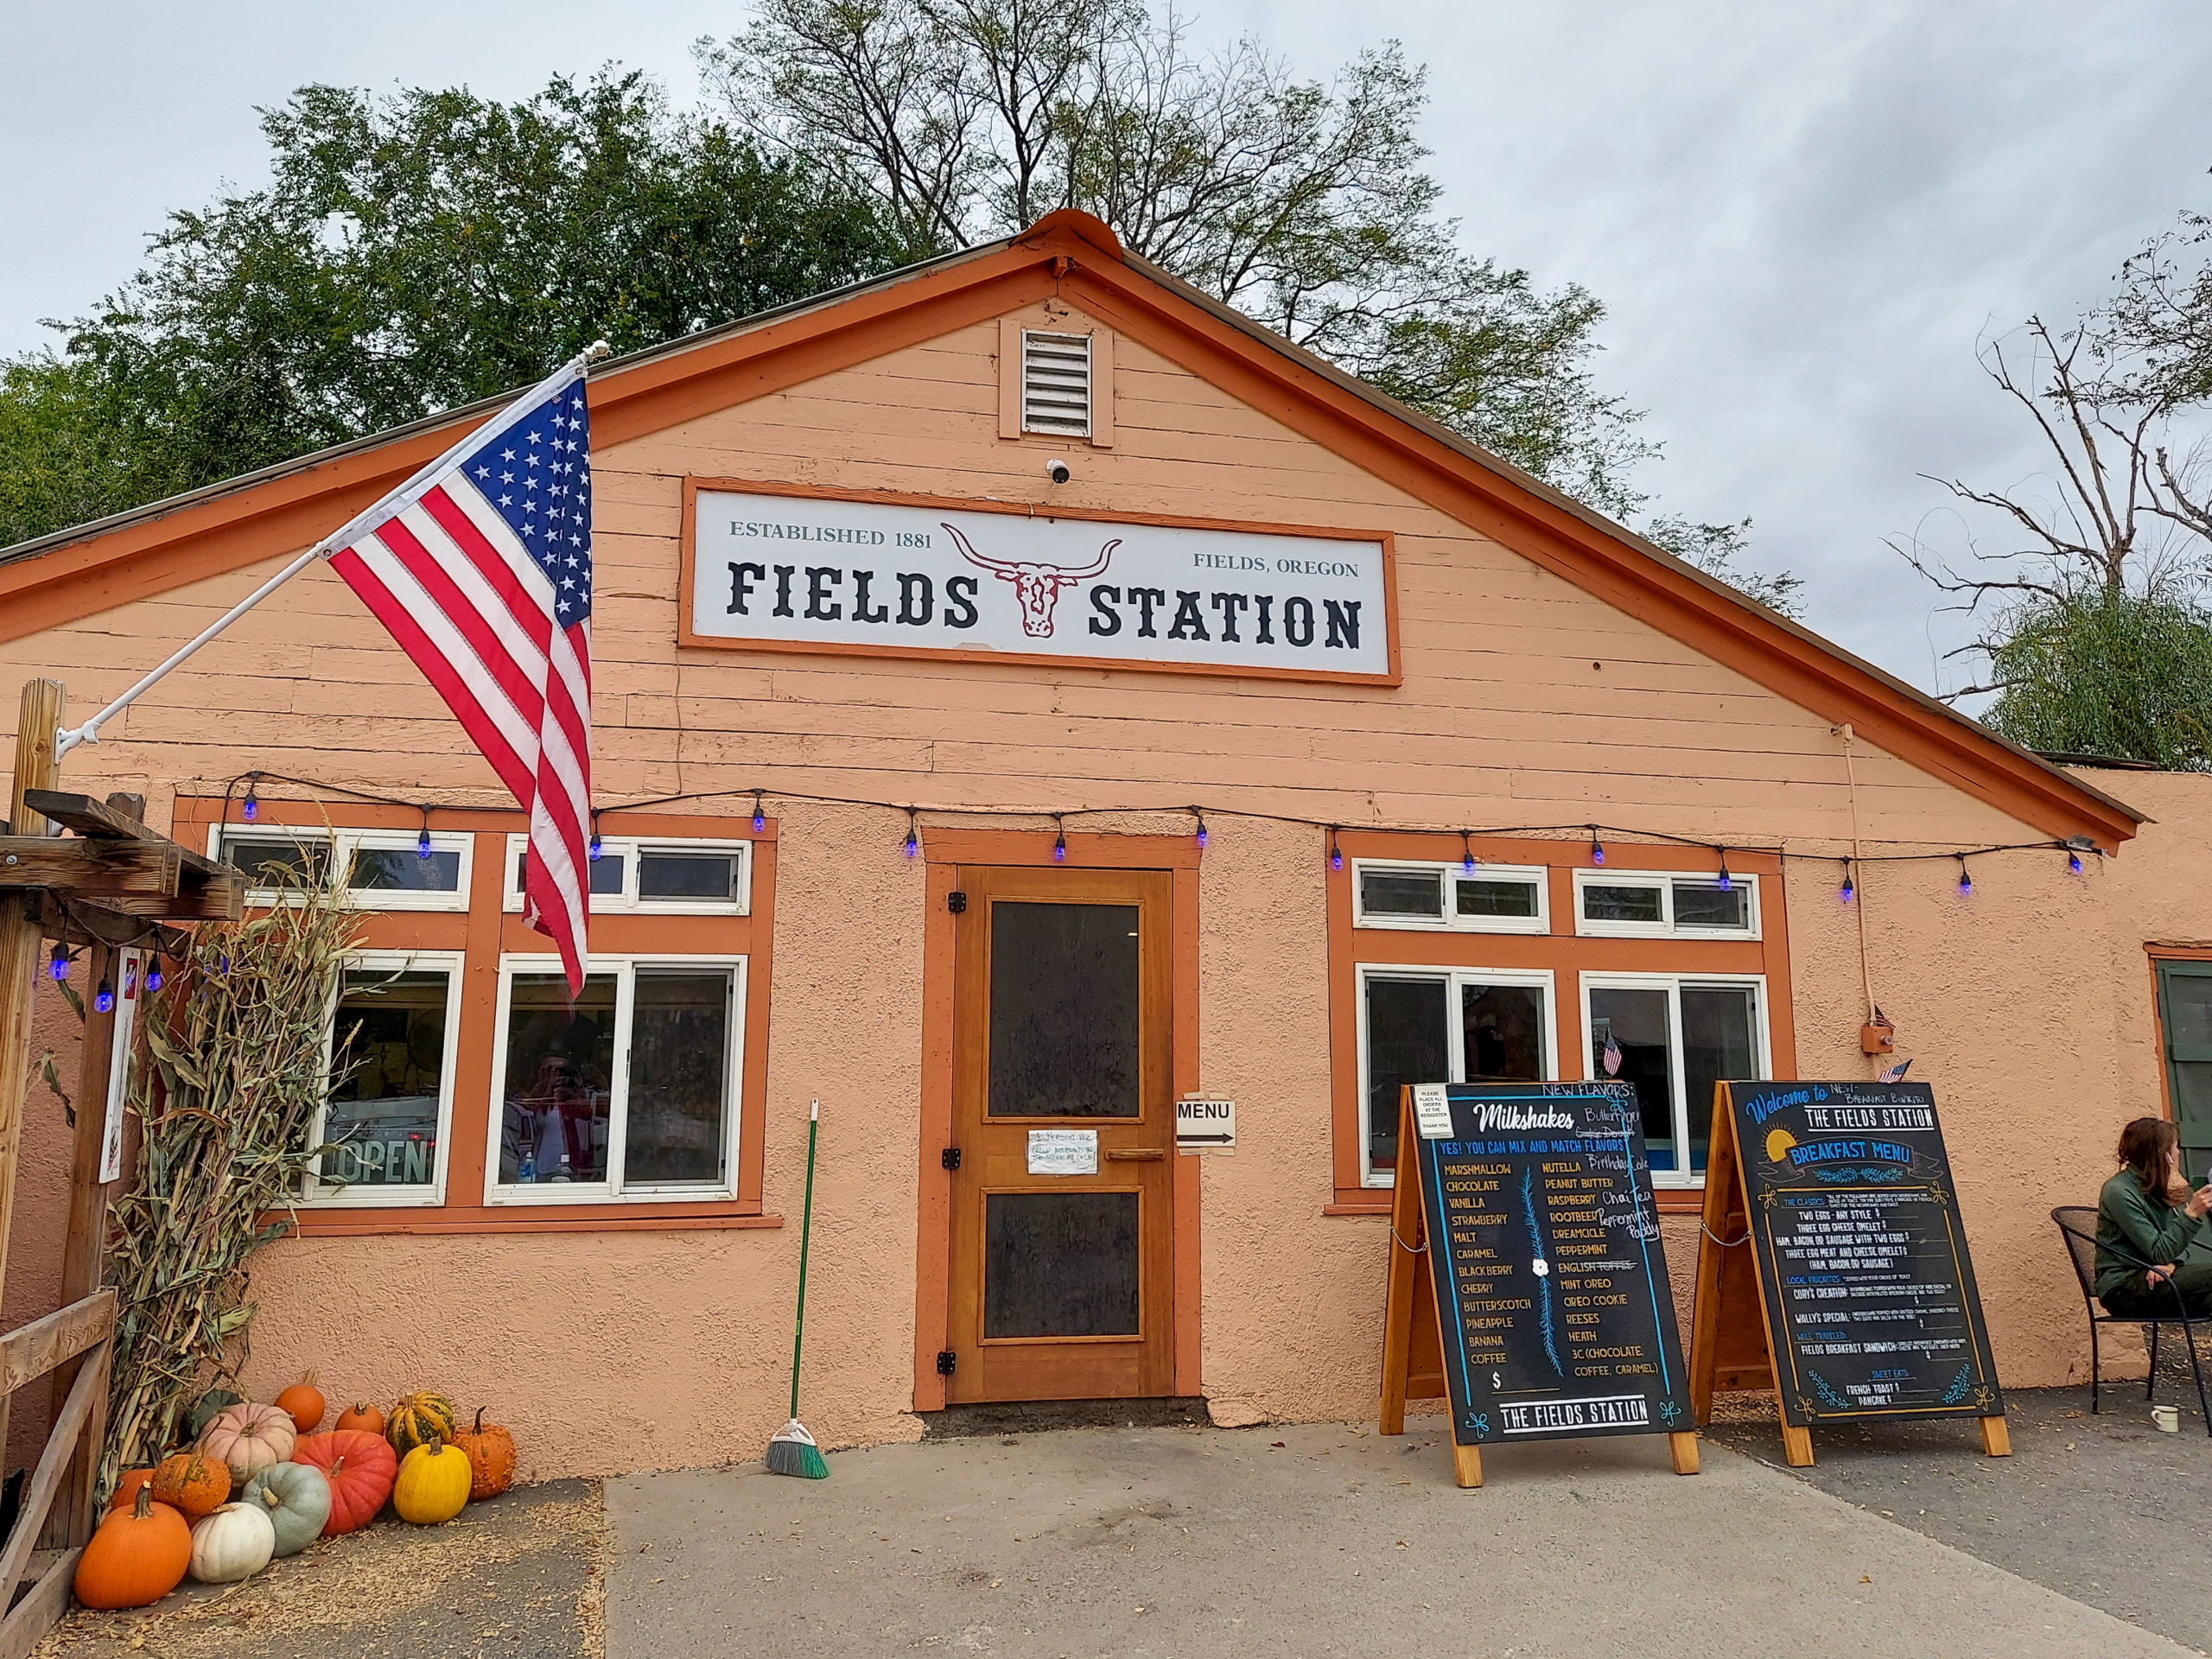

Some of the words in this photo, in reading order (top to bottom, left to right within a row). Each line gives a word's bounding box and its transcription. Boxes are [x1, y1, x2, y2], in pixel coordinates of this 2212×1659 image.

[729, 521, 885, 545] ESTABLISHED
[895, 532, 931, 549] 1881
[1193, 553, 1270, 574] FIELDS,
[1277, 559, 1359, 577] OREGON
[727, 562, 978, 628] FIELDS
[1089, 585, 1362, 649] STATION
[1542, 1084, 1573, 1096] NEW
[1579, 1084, 1634, 1098] FLAVORS:
[1745, 1089, 1809, 1124] Welcome
[1815, 1084, 1828, 1102] to
[1178, 1103, 1230, 1119] MENU
[1473, 1103, 1574, 1133] Milkshakes
[1805, 1109, 1830, 1128] THE
[1834, 1109, 1877, 1128] FIELDS
[1882, 1108, 1934, 1127] STATION
[1440, 1142, 1462, 1154] YES!
[1465, 1141, 1484, 1154] YOU
[1488, 1141, 1506, 1154] CAN
[1509, 1141, 1525, 1154] MIX
[1529, 1141, 1547, 1153] AND
[1551, 1140, 1581, 1152] MATCH
[1585, 1139, 1624, 1152] FLAVORS
[1789, 1141, 1866, 1166] BREAKFAST
[1872, 1141, 1910, 1162] MENU
[337, 1141, 428, 1182] OPEN
[1541, 1161, 1582, 1173] NUTELLA
[1585, 1154, 1630, 1178] Birthday
[1444, 1164, 1511, 1175] MARSHMALLOW
[1446, 1180, 1500, 1192] CHOCOLATE
[1545, 1179, 1578, 1189] PEANUT
[1581, 1178, 1613, 1188] BUTTER
[1548, 1194, 1597, 1205] RASPBERRY
[1602, 1190, 1631, 1205] Chai
[1628, 1185, 1652, 1204] Tea
[1449, 1198, 1485, 1209] VANILLA
[1452, 1214, 1508, 1226] STRAWBERRY
[1549, 1211, 1598, 1223] ROOTBEER
[1798, 1211, 1814, 1220] TWO
[1815, 1211, 1831, 1220] EGGS
[1836, 1211, 1848, 1220] ANY
[1850, 1210, 1872, 1219] STYLE
[1875, 1208, 1880, 1218] $
[1796, 1224, 1818, 1233] THREE
[1818, 1224, 1831, 1232] EGG
[1832, 1223, 1855, 1231] CHEESE
[1856, 1222, 1881, 1231] OMELET
[1882, 1219, 1886, 1229] $
[1453, 1232, 1476, 1243] MALT
[1552, 1228, 1606, 1239] DREAMCICLE
[1815, 1236, 1824, 1245] OR
[1825, 1235, 1855, 1244] SAUSAGE
[1854, 1235, 1872, 1244] WITH
[1873, 1234, 1888, 1243] TWO
[1888, 1233, 1904, 1243] EGGS
[1904, 1231, 1910, 1241] $
[1457, 1249, 1497, 1259] CARAMEL
[1555, 1244, 1607, 1255] PEPPERMINT
[1784, 1249, 1806, 1259] THREE
[1806, 1249, 1820, 1258] EGG
[1820, 1248, 1836, 1258] MEAT
[1839, 1247, 1853, 1257] AND
[1853, 1247, 1878, 1257] CHEESE
[1878, 1246, 1903, 1256] OMELET
[1558, 1262, 1597, 1273] ENGLISH
[1851, 1259, 1860, 1268] OR
[1861, 1258, 1894, 1268] SAUSAGE)
[1560, 1280, 1581, 1290] MINT
[1584, 1279, 1611, 1289] OREO
[1787, 1275, 1807, 1284] LOCAL
[1461, 1283, 1493, 1294] CHERRY
[1793, 1287, 1815, 1300] CORY'S
[1463, 1299, 1532, 1312] BUTTERSCOTCH
[1564, 1296, 1590, 1307] OREO
[1593, 1294, 1628, 1306] COOKIE
[1465, 1317, 1514, 1330] PINEAPPLE
[1566, 1313, 1600, 1325] REESES
[1795, 1313, 1821, 1324] WALLY'S
[1469, 1336, 1503, 1347] BANANA
[1568, 1331, 1597, 1342] HEATH
[1796, 1332, 1813, 1341] WELL
[1572, 1350, 1584, 1359] 3C
[1801, 1344, 1824, 1356] FIELDS
[1825, 1343, 1862, 1355] BREAKFAST
[1864, 1342, 1897, 1353] SANDWICH:
[1471, 1353, 1507, 1364] COFFEE
[1615, 1362, 1659, 1375] CARAMEL)
[1872, 1370, 1891, 1379] SWEET
[1492, 1371, 1501, 1389] $
[1846, 1384, 1871, 1395] FRENCH
[1872, 1383, 1893, 1394] TOAST
[1895, 1382, 1899, 1391] $
[1858, 1395, 1887, 1407] PANCAKE
[1887, 1395, 1892, 1403] $
[1500, 1408, 1529, 1428] THE
[1535, 1404, 1583, 1427] FIELDS
[1590, 1400, 1648, 1424] STATION
